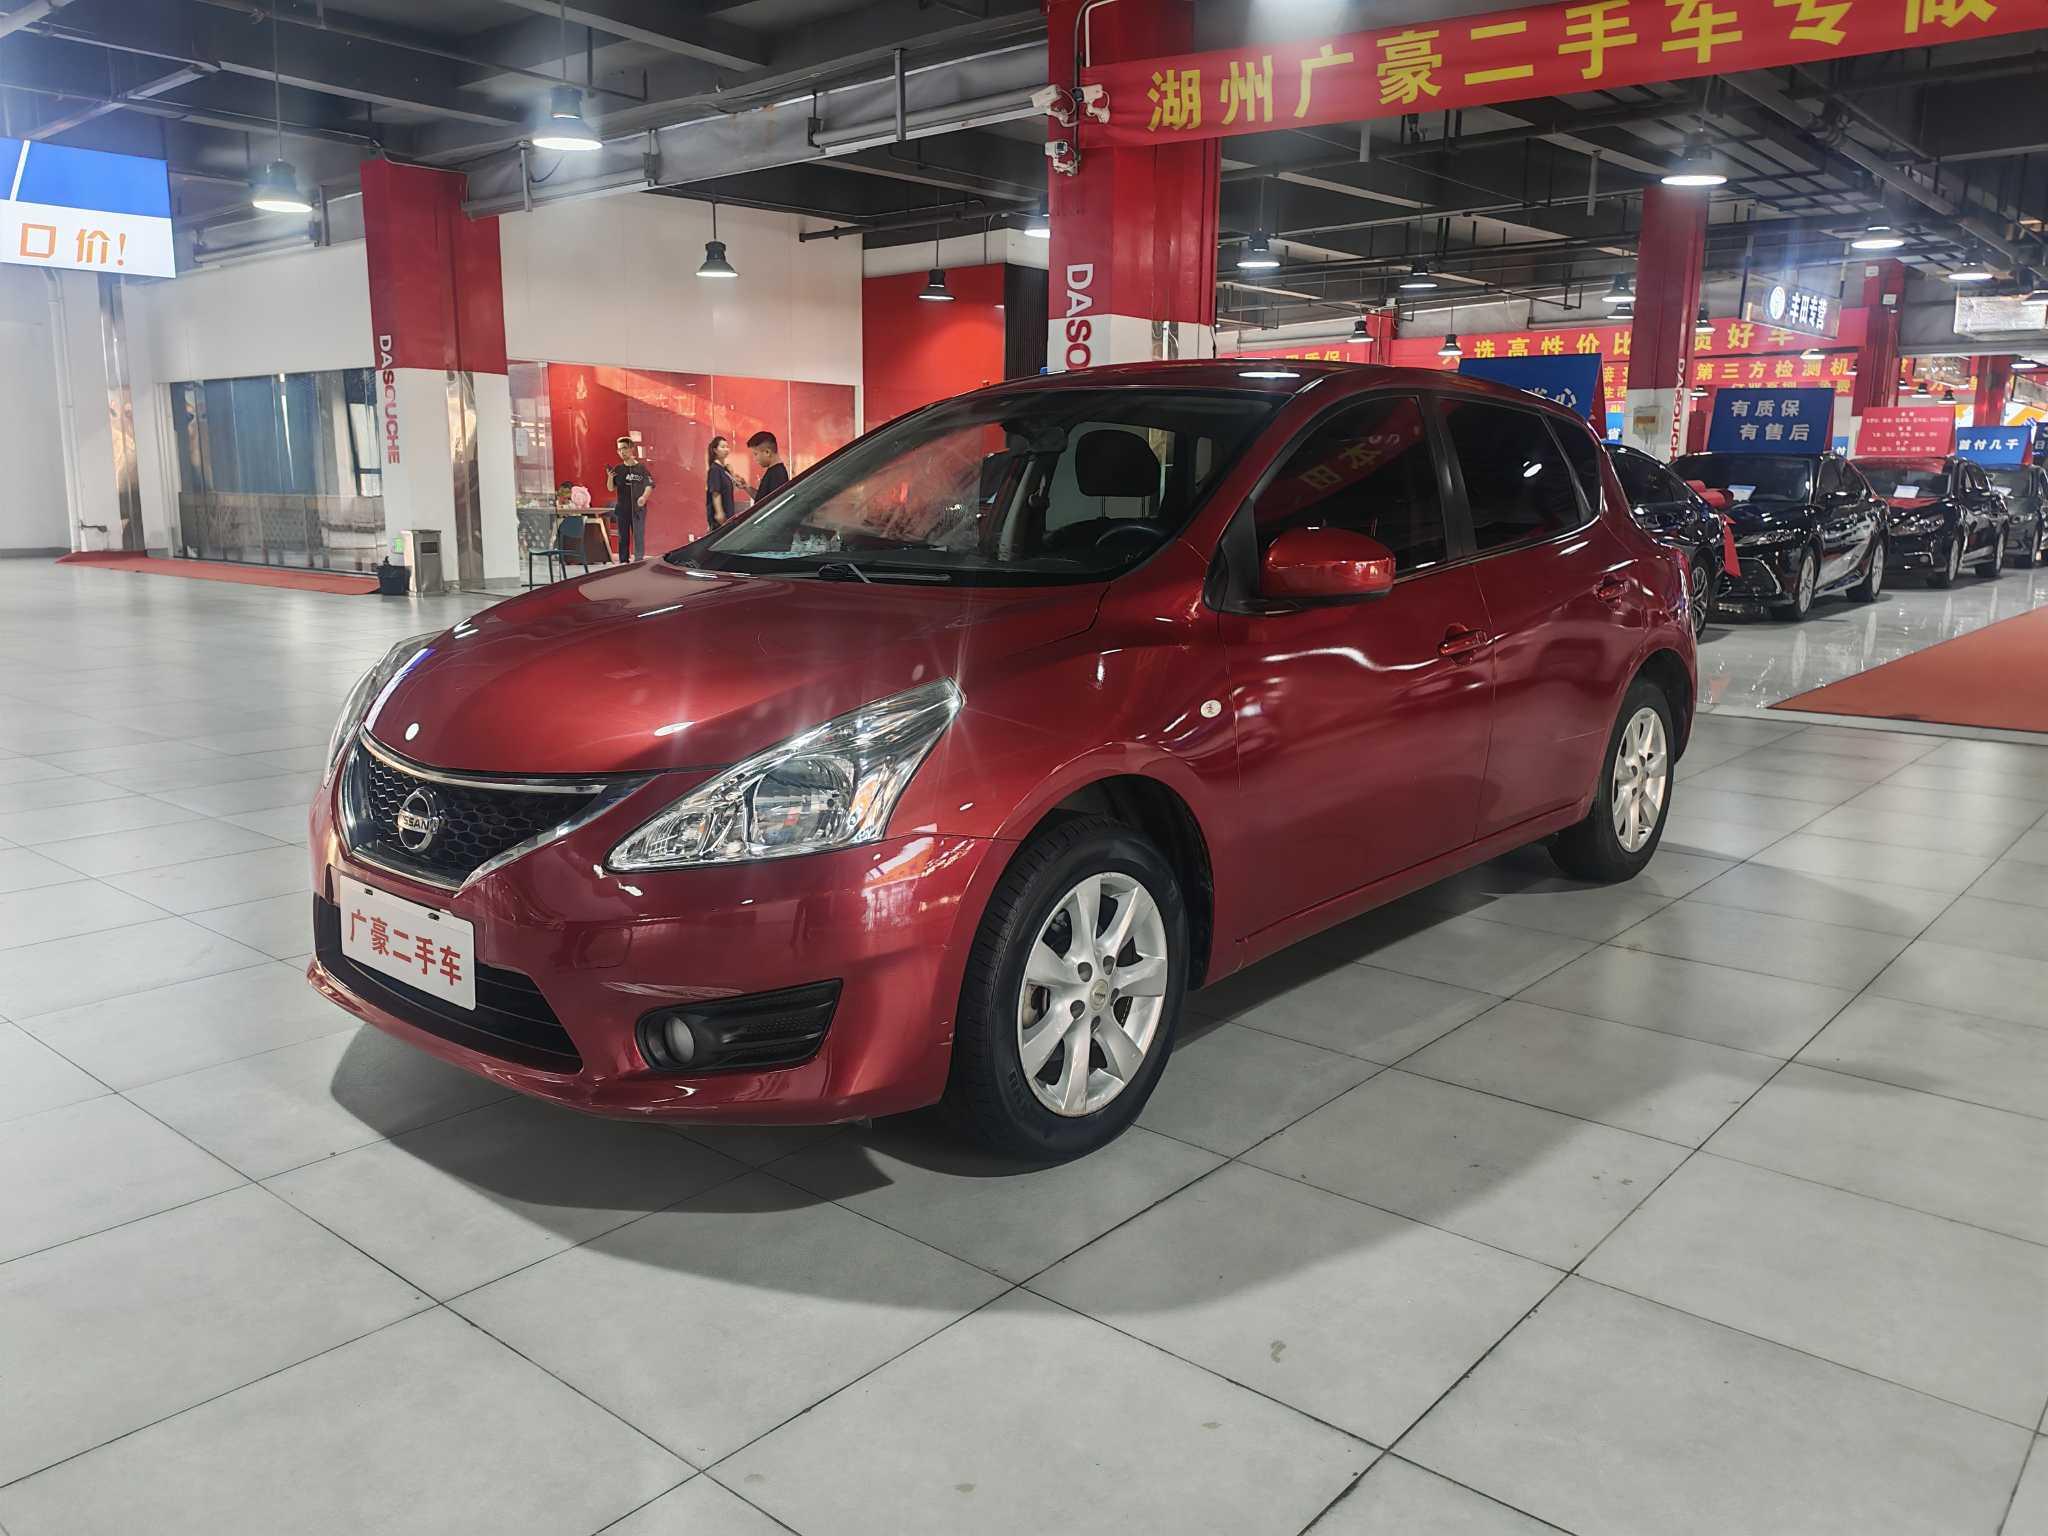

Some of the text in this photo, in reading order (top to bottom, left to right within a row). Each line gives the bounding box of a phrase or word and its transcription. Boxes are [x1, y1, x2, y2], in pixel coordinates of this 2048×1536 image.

[1731, 399, 1800, 417] 有质保
[1740, 423, 1810, 440] 有售后
[1958, 438, 2019, 450] 首付几千
[350, 908, 463, 986] 广豪二手车
